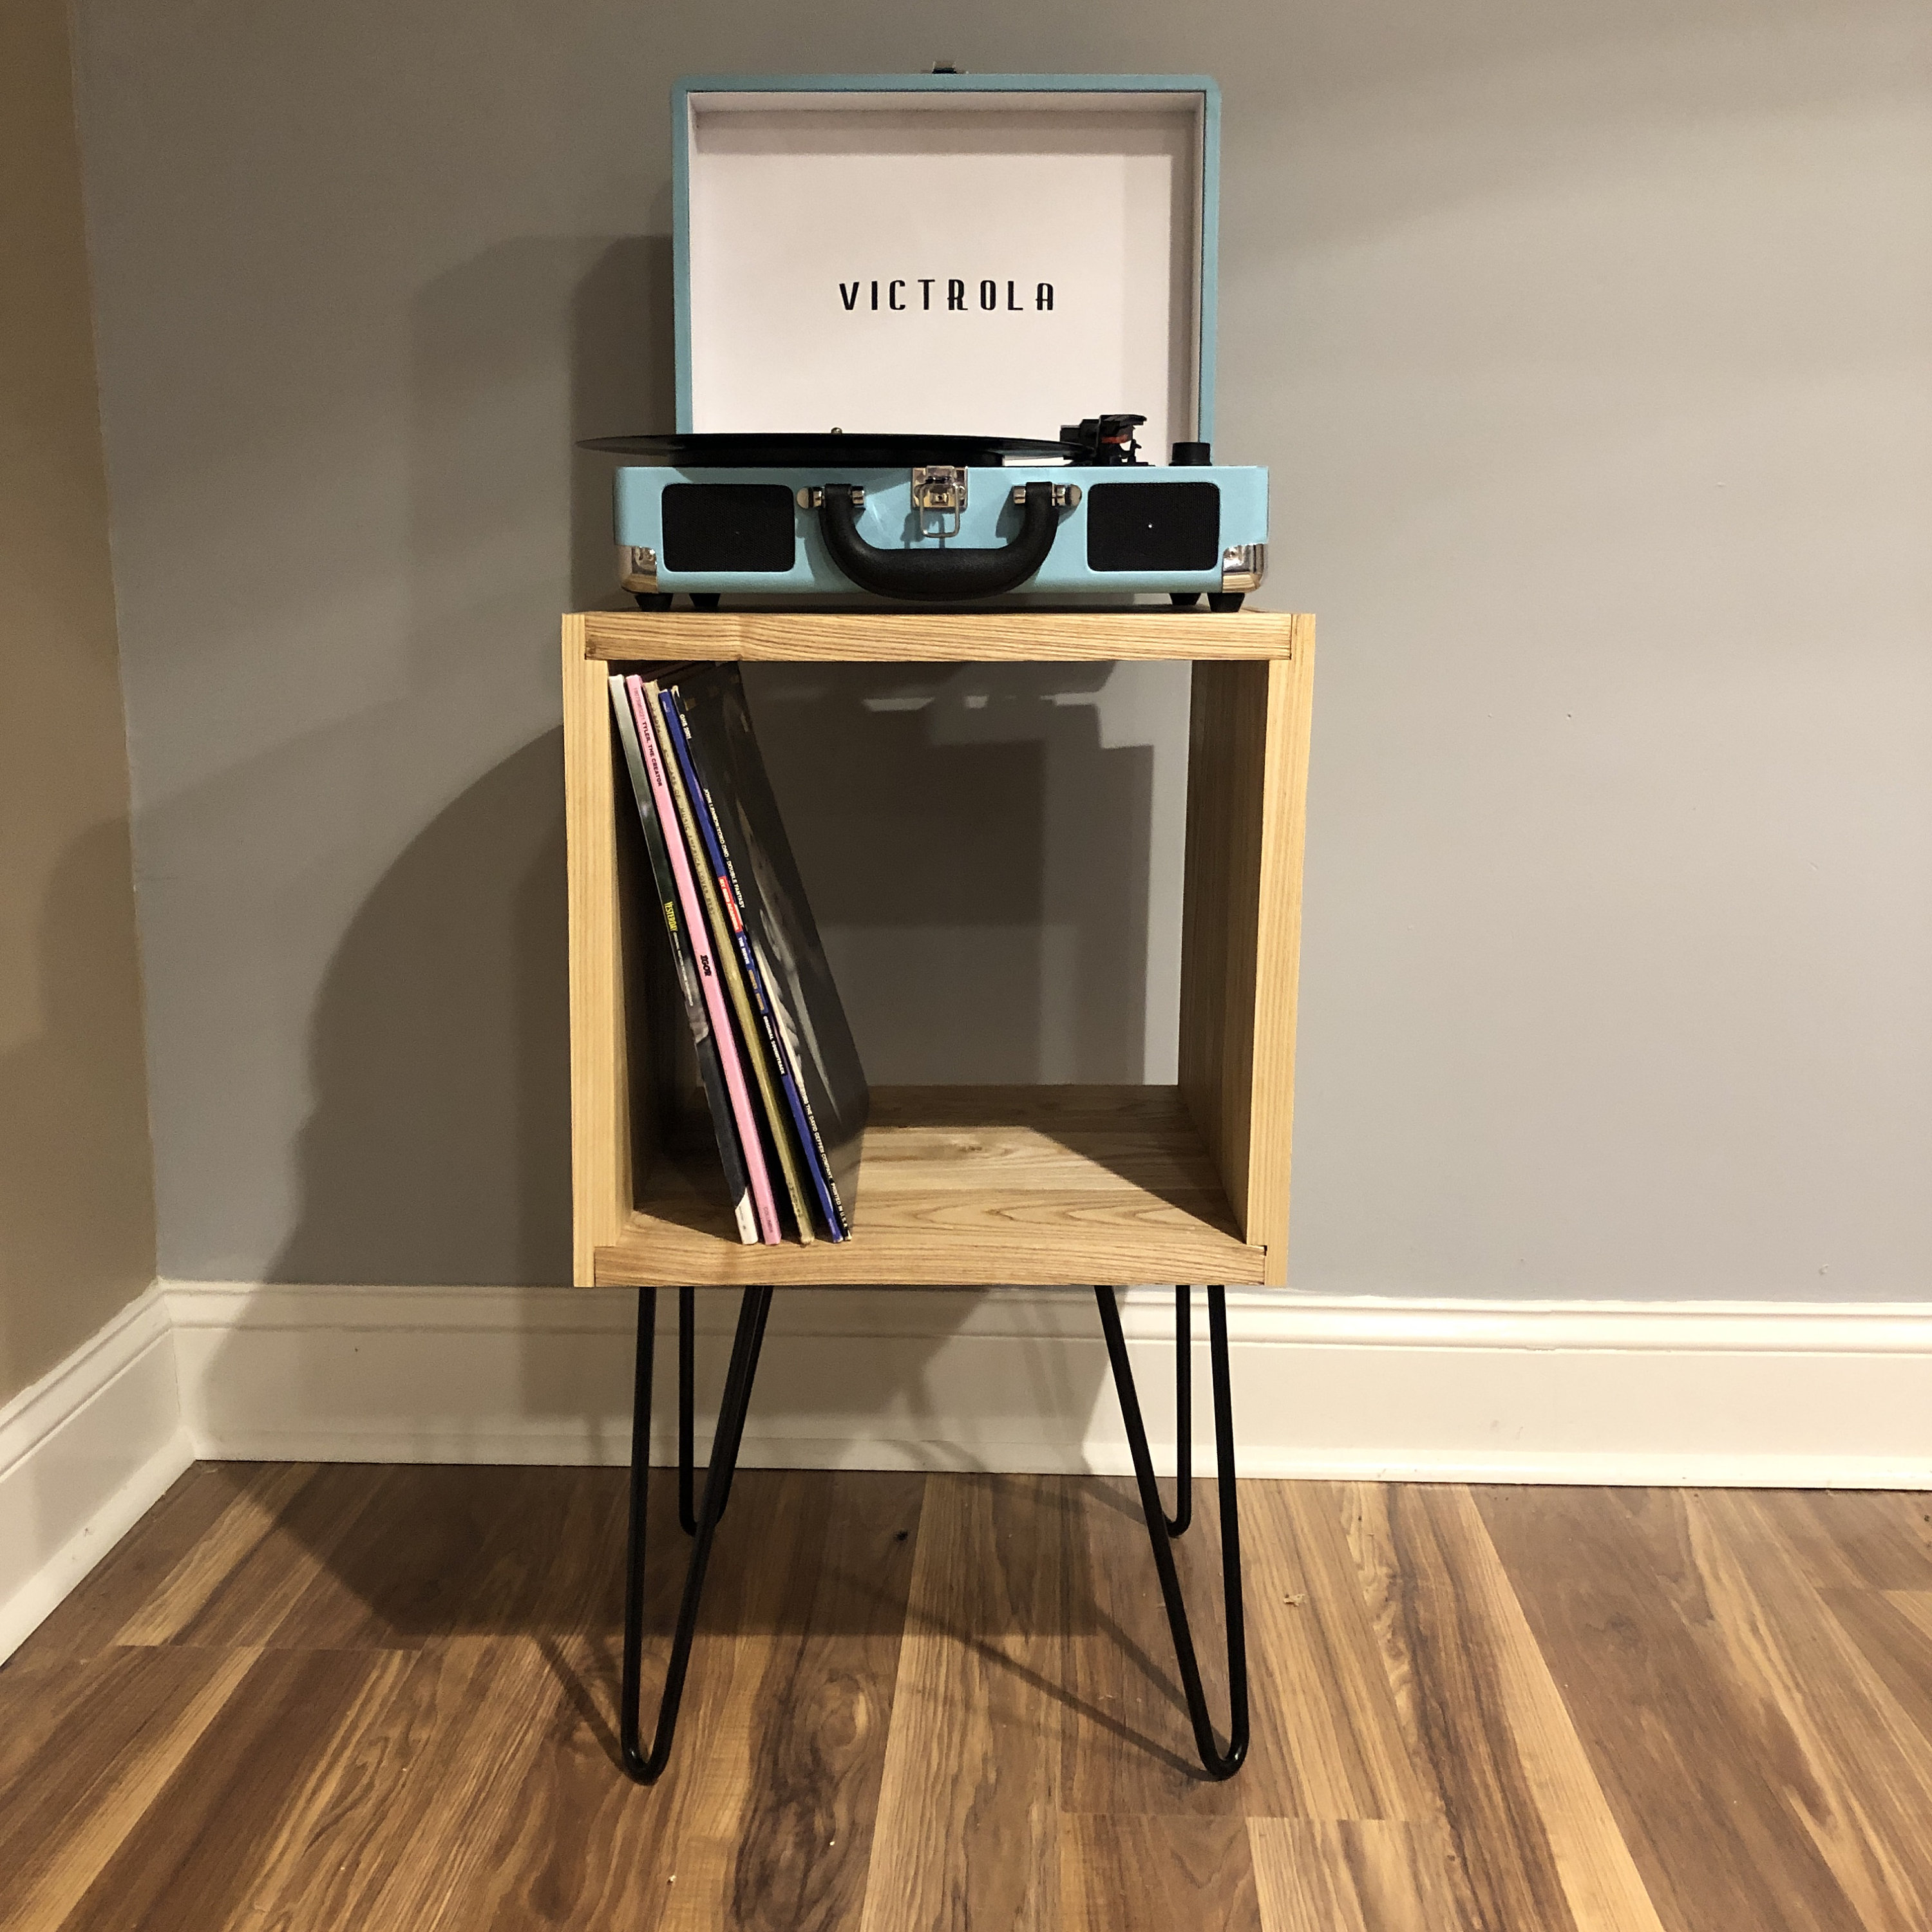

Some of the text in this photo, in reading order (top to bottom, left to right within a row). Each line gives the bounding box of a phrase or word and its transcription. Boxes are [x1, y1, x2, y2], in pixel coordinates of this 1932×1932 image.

[839, 279, 1053, 310] VICTROLA
[652, 758, 661, 786] CREATOR
[703, 788, 712, 803] JOHN
[726, 860, 737, 883] DOUBLE
[734, 884, 744, 908] FANTASY
[664, 902, 677, 931] YESTERDAY
[700, 954, 711, 976] IGOR
[763, 1016, 773, 1039] ORIGINAL
[771, 1041, 784, 1074] SOUNDTRACK
[809, 1115, 817, 1131] DAVID
[815, 1132, 824, 1152] GEFFEN
[821, 1153, 832, 1178] COMPANY
[831, 1182, 840, 1204] PRINTED
